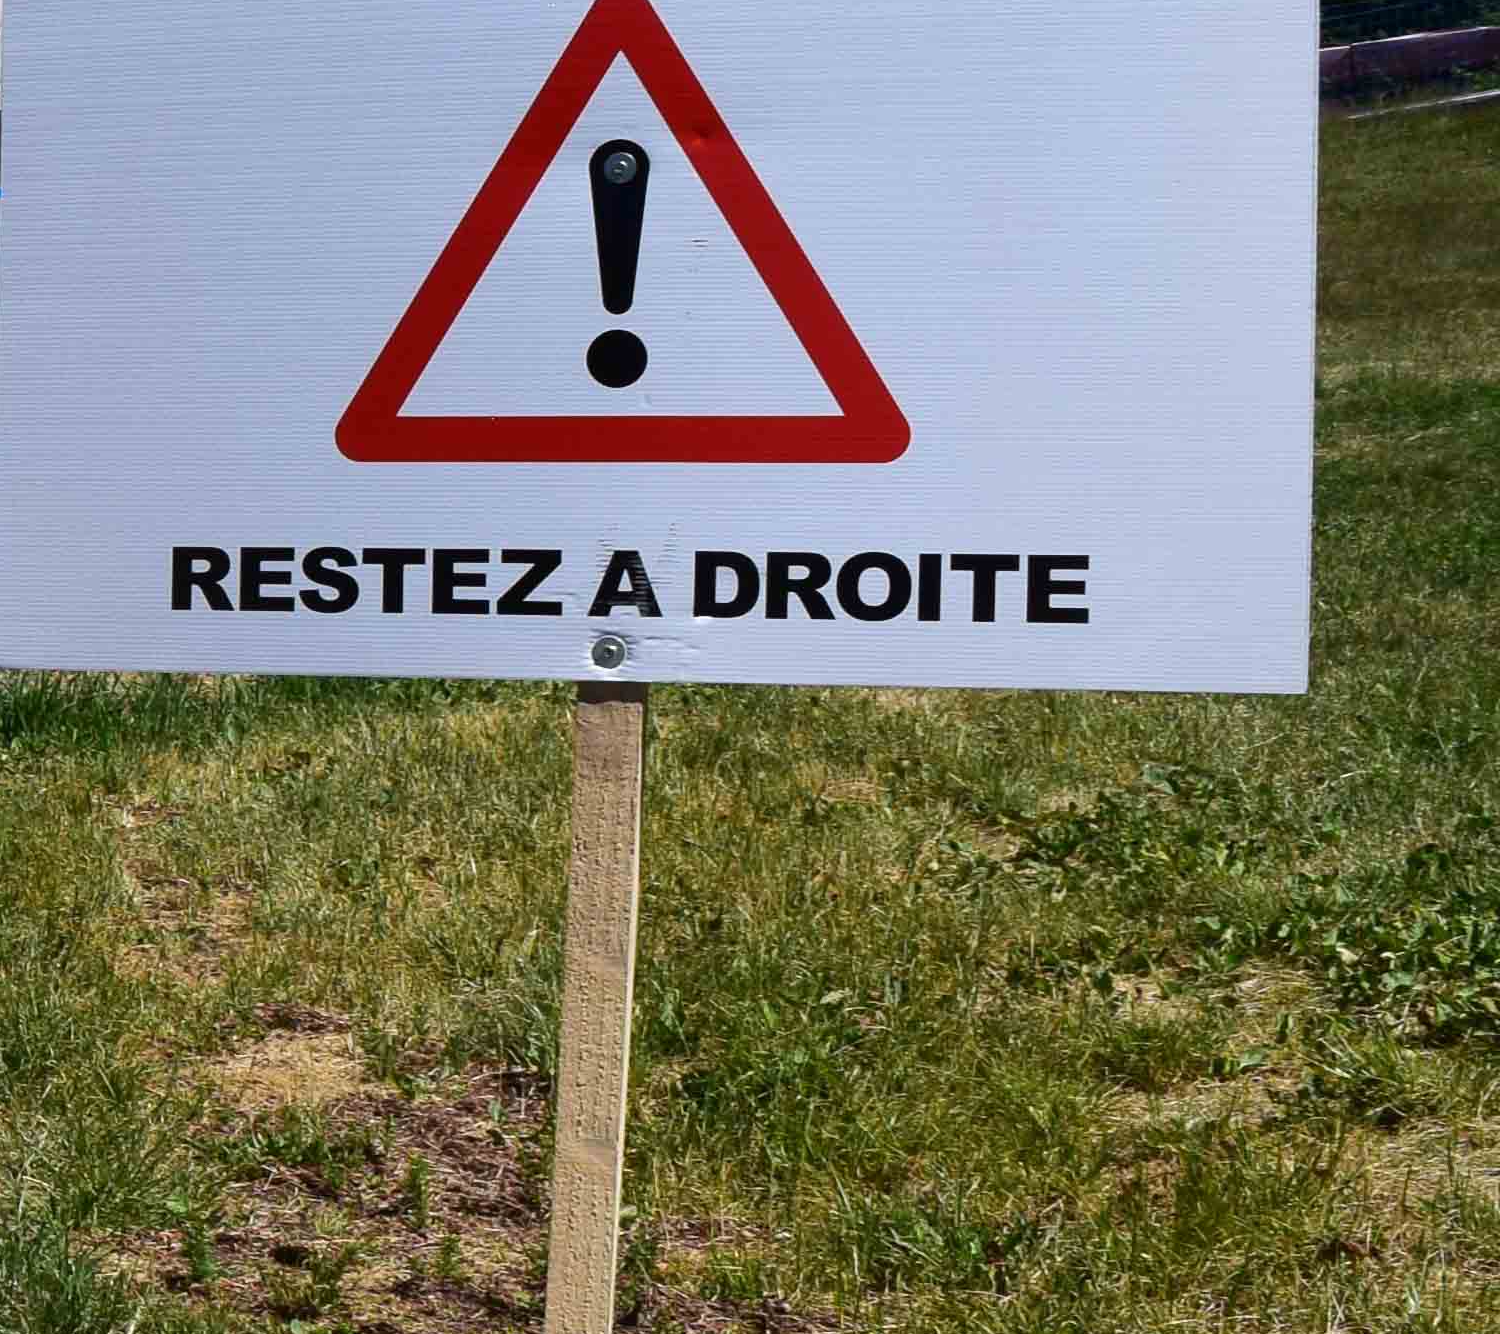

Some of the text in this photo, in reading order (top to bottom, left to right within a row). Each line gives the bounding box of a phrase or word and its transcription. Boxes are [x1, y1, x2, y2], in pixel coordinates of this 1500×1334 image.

[170, 545, 1091, 625] RESTEZ A DROITE
